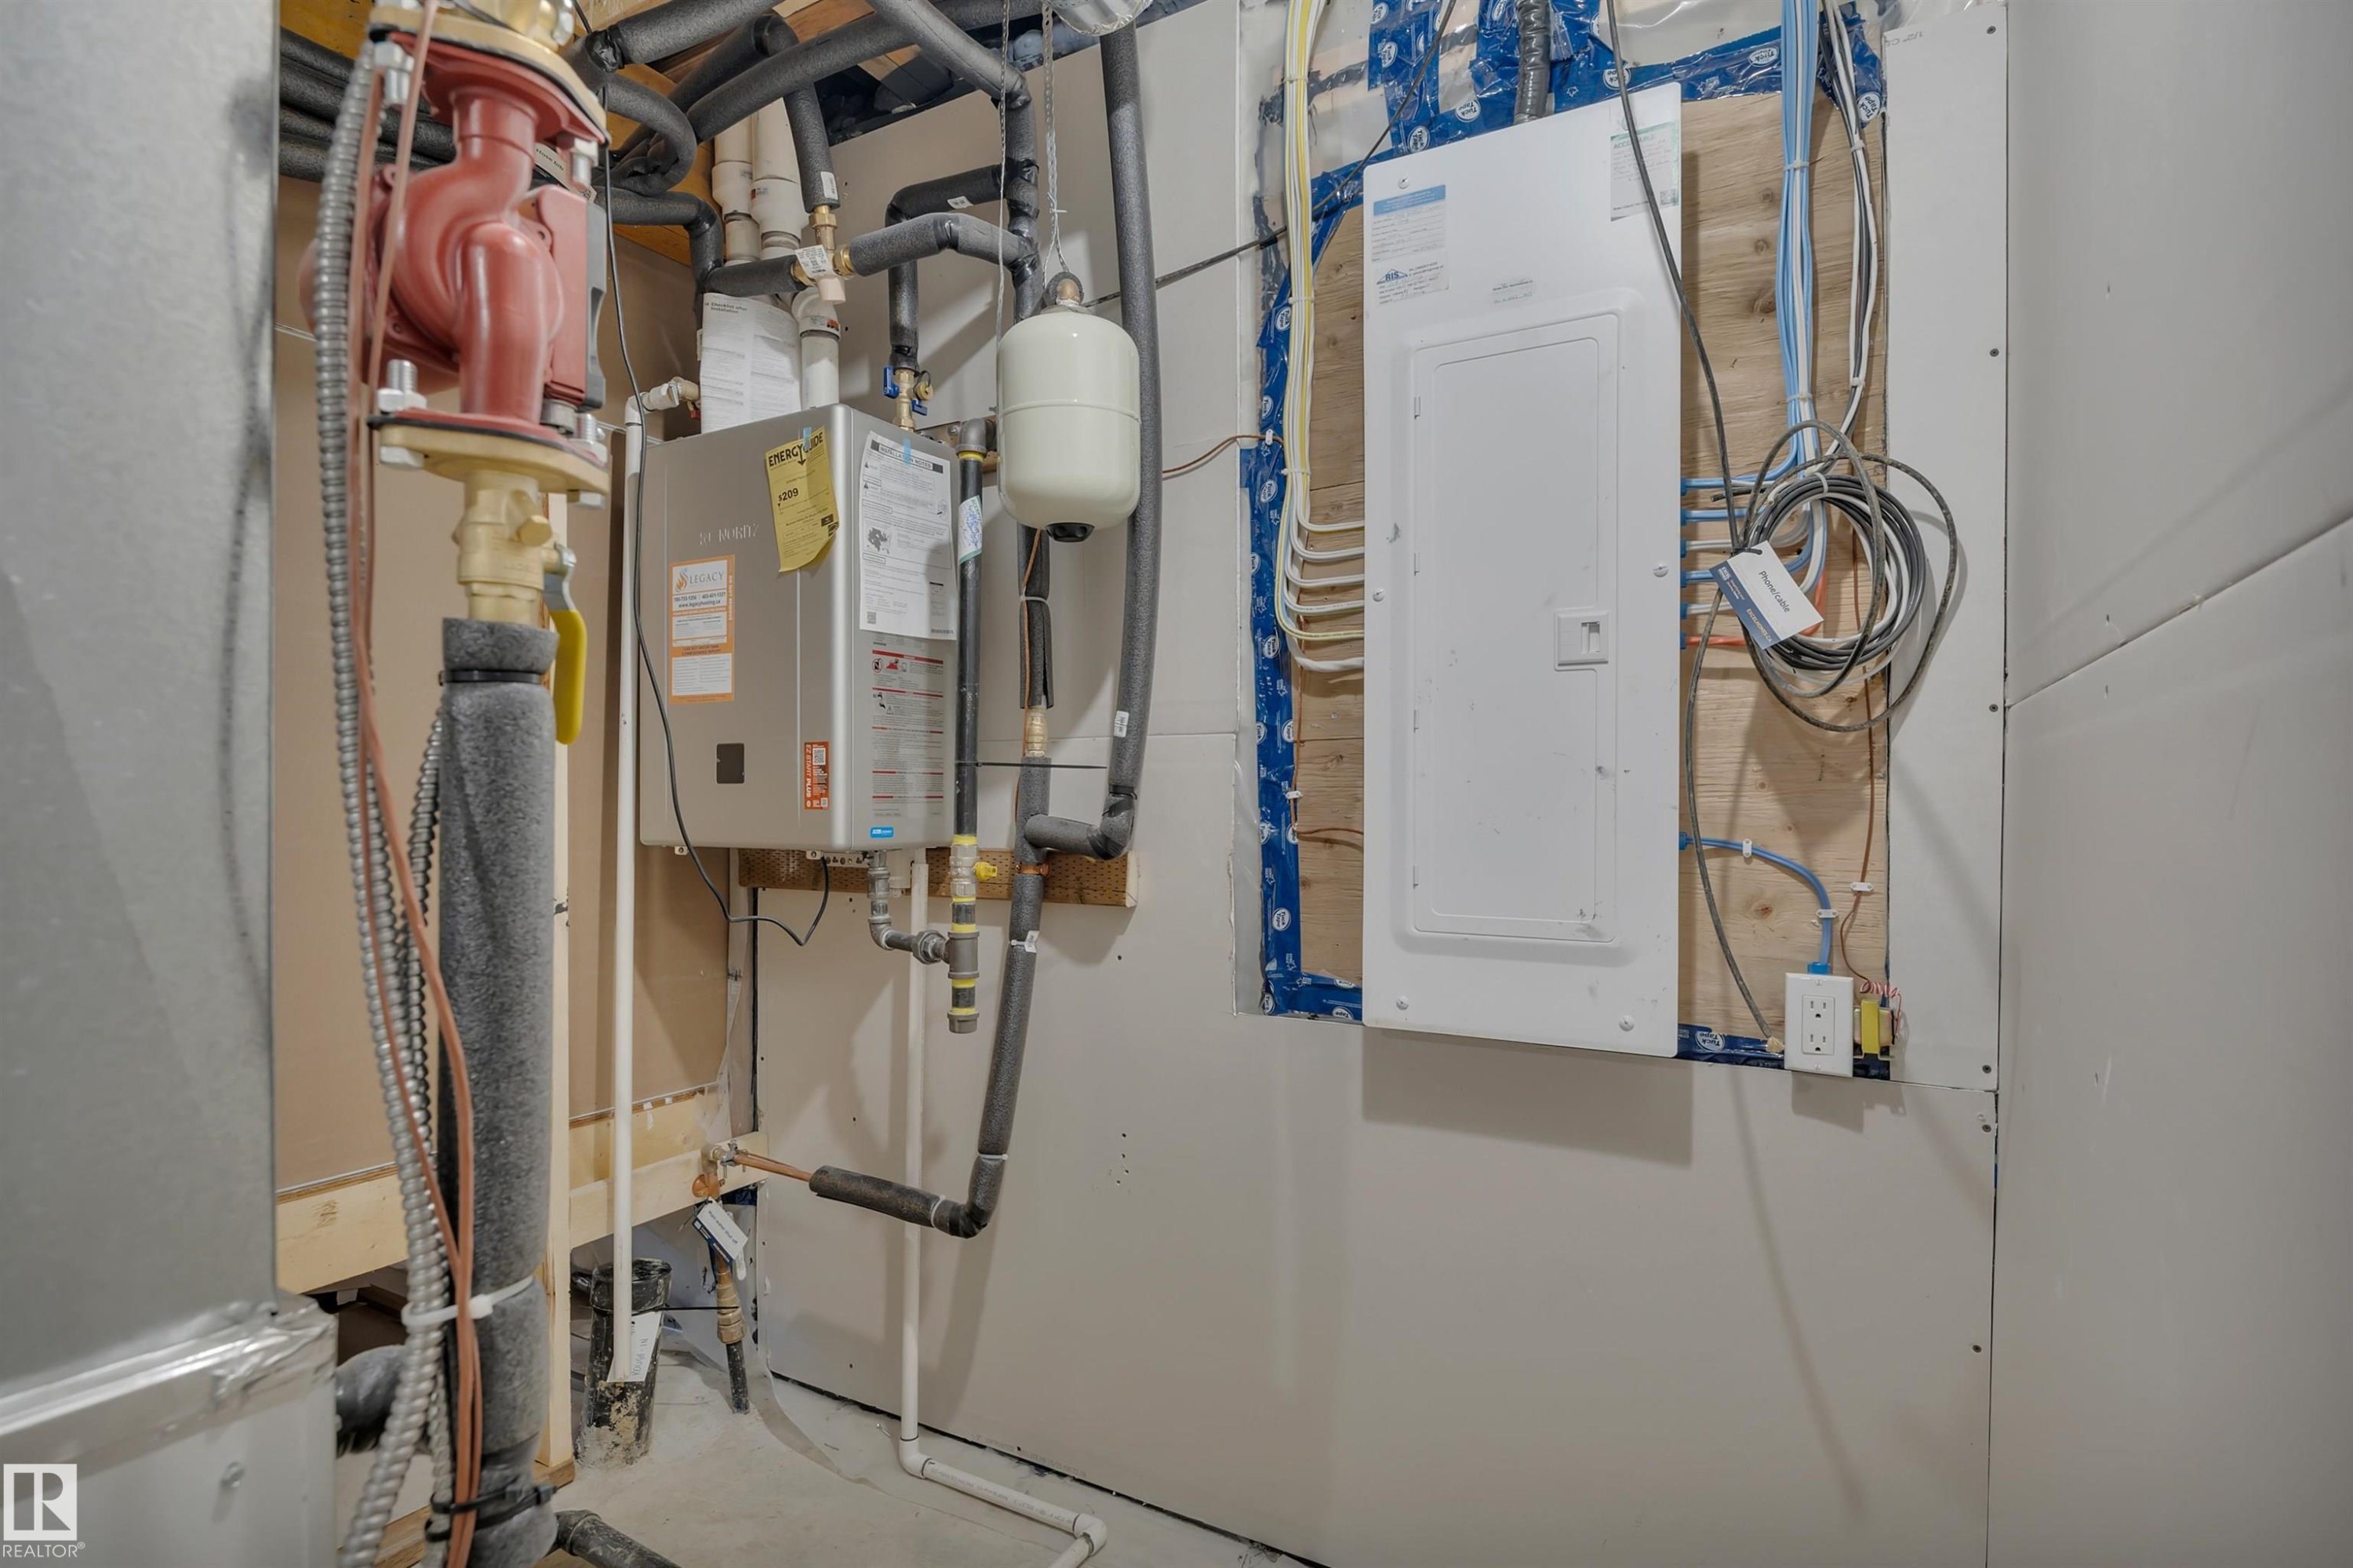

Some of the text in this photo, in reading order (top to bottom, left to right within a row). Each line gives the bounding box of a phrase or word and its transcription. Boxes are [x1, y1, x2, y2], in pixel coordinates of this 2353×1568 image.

[1755, 50, 1774, 61] Tuck
[1859, 103, 1873, 118] Tuck
[1865, 96, 1878, 112] Tape
[1460, 107, 1478, 117] Tuck
[880, 446, 933, 469] INSTALLAN NOTES
[778, 488, 798, 501] $209
[689, 570, 724, 584] LEGACY
[1758, 570, 1791, 613] Phone/cable
